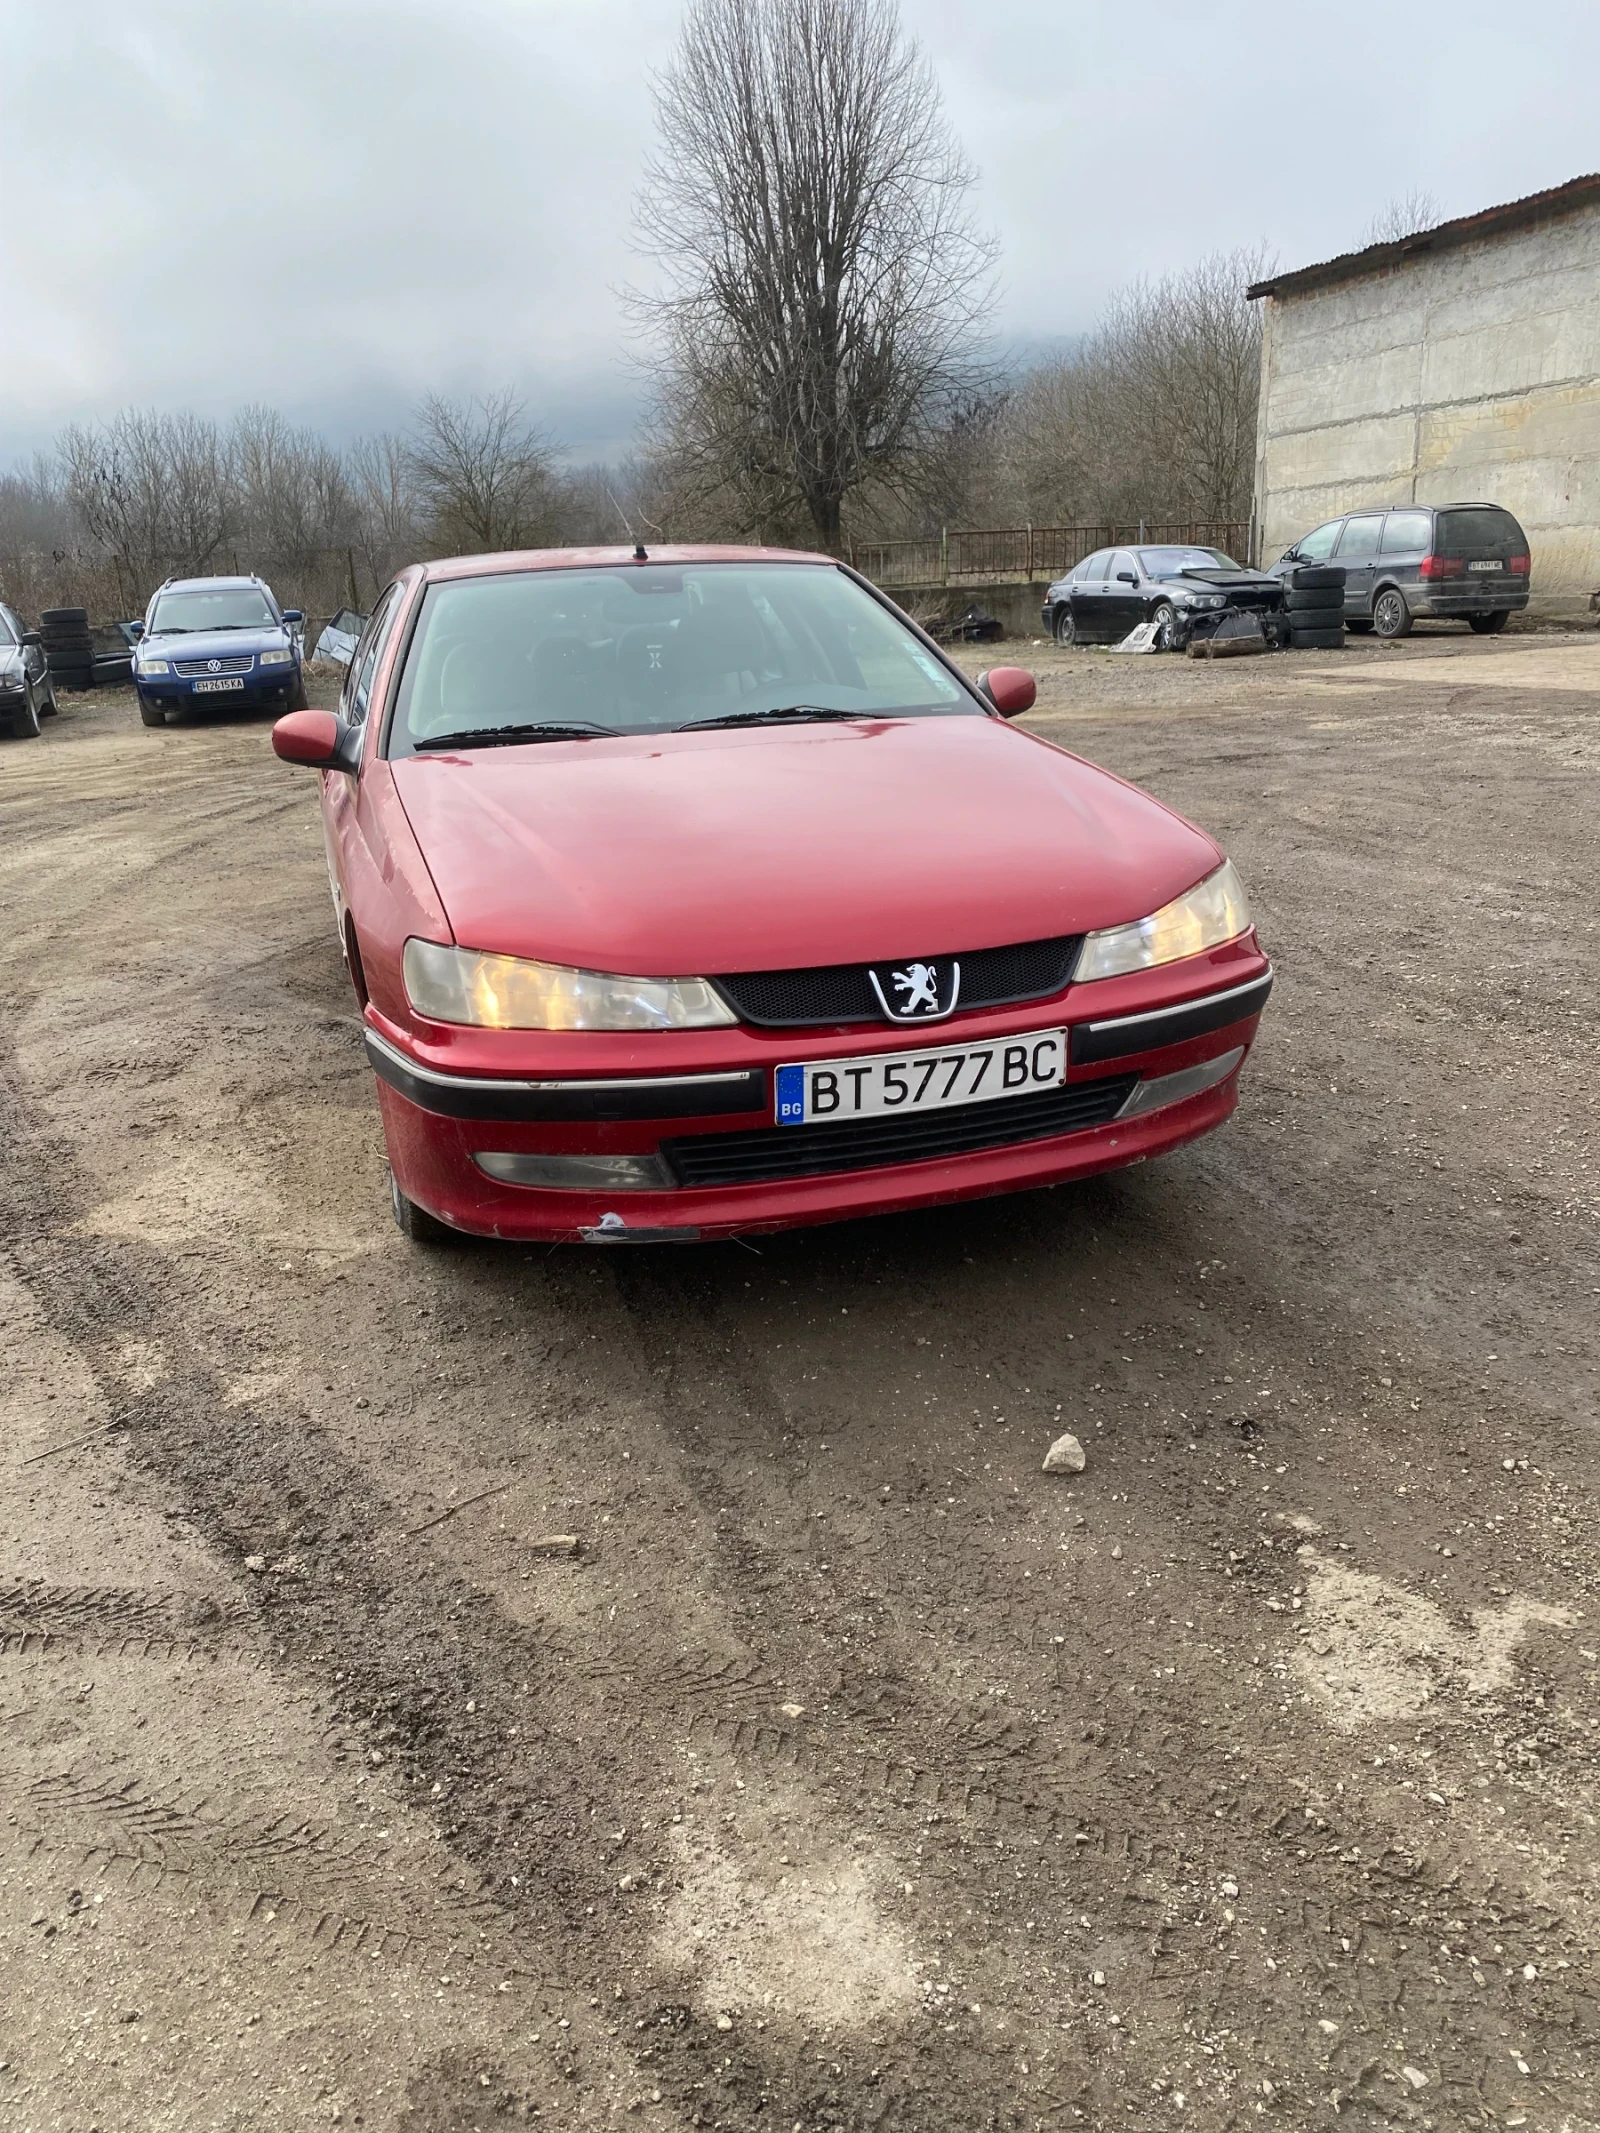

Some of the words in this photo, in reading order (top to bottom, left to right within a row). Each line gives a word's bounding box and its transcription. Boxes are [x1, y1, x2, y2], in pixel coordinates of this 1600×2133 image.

[196, 682, 209, 691] EH
[209, 680, 230, 690] 2615
[230, 679, 243, 688] KA
[811, 1067, 872, 1114] BT
[883, 1051, 993, 1105] 5777
[1002, 1040, 1057, 1089] BC
[781, 1103, 801, 1116] BG
